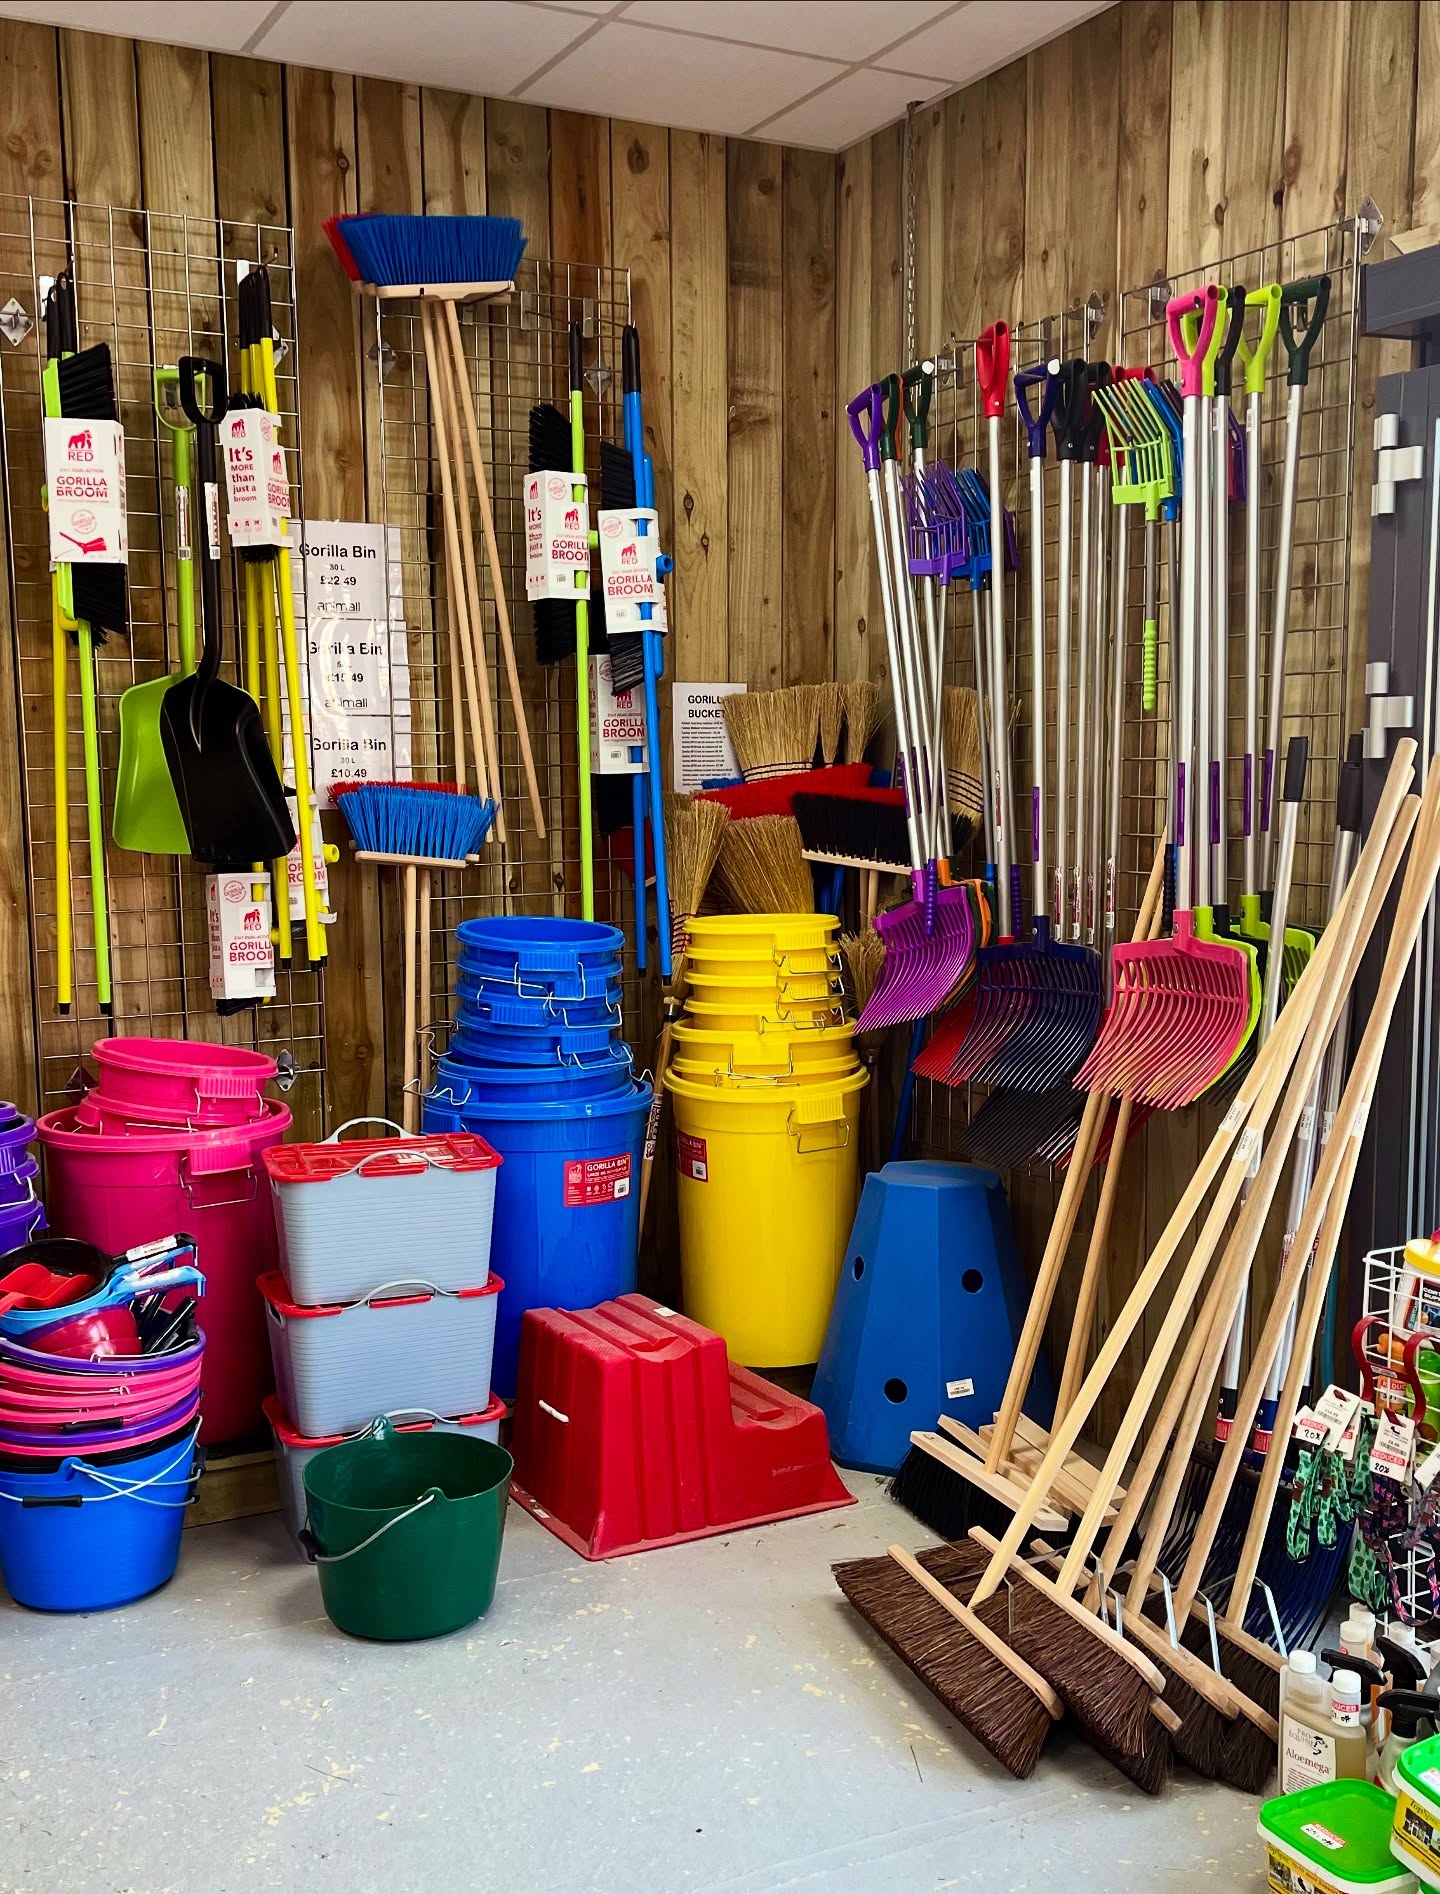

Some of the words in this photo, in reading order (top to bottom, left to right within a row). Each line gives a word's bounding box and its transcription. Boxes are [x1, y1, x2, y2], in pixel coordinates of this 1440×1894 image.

[68, 451, 94, 462] RED
[229, 446, 253, 462] It's
[56, 476, 107, 487] GORILLA
[232, 474, 255, 482] than
[56, 486, 108, 498] BROOM
[232, 484, 250, 495] just
[267, 482, 289, 496] GORILL
[528, 507, 542, 522] It's
[552, 540, 588, 550] GORILL
[299, 543, 348, 558] Gorilla
[352, 545, 377, 559] Bin
[607, 574, 653, 585] GORILLA
[607, 584, 654, 596] BROOM
[309, 641, 355, 655] Gila
[359, 642, 383, 656] Bin
[616, 701, 633, 709] RED
[687, 695, 725, 704] GORILL
[603, 718, 645, 728] GORILLA
[603, 728, 645, 738] BROOM
[363, 738, 387, 751] Bin
[331, 768, 367, 778] £10.49
[244, 923, 261, 931] RED
[229, 941, 272, 951] GORILL
[587, 1160, 616, 1172] GORILLA
[616, 1158, 627, 1167] BIN
[1300, 1419, 1329, 1432] REDUCE
[1370, 1449, 1405, 1466] REDUCED
[1374, 1462, 1390, 1474] 20%
[1286, 1747, 1330, 1774] Aloemega
